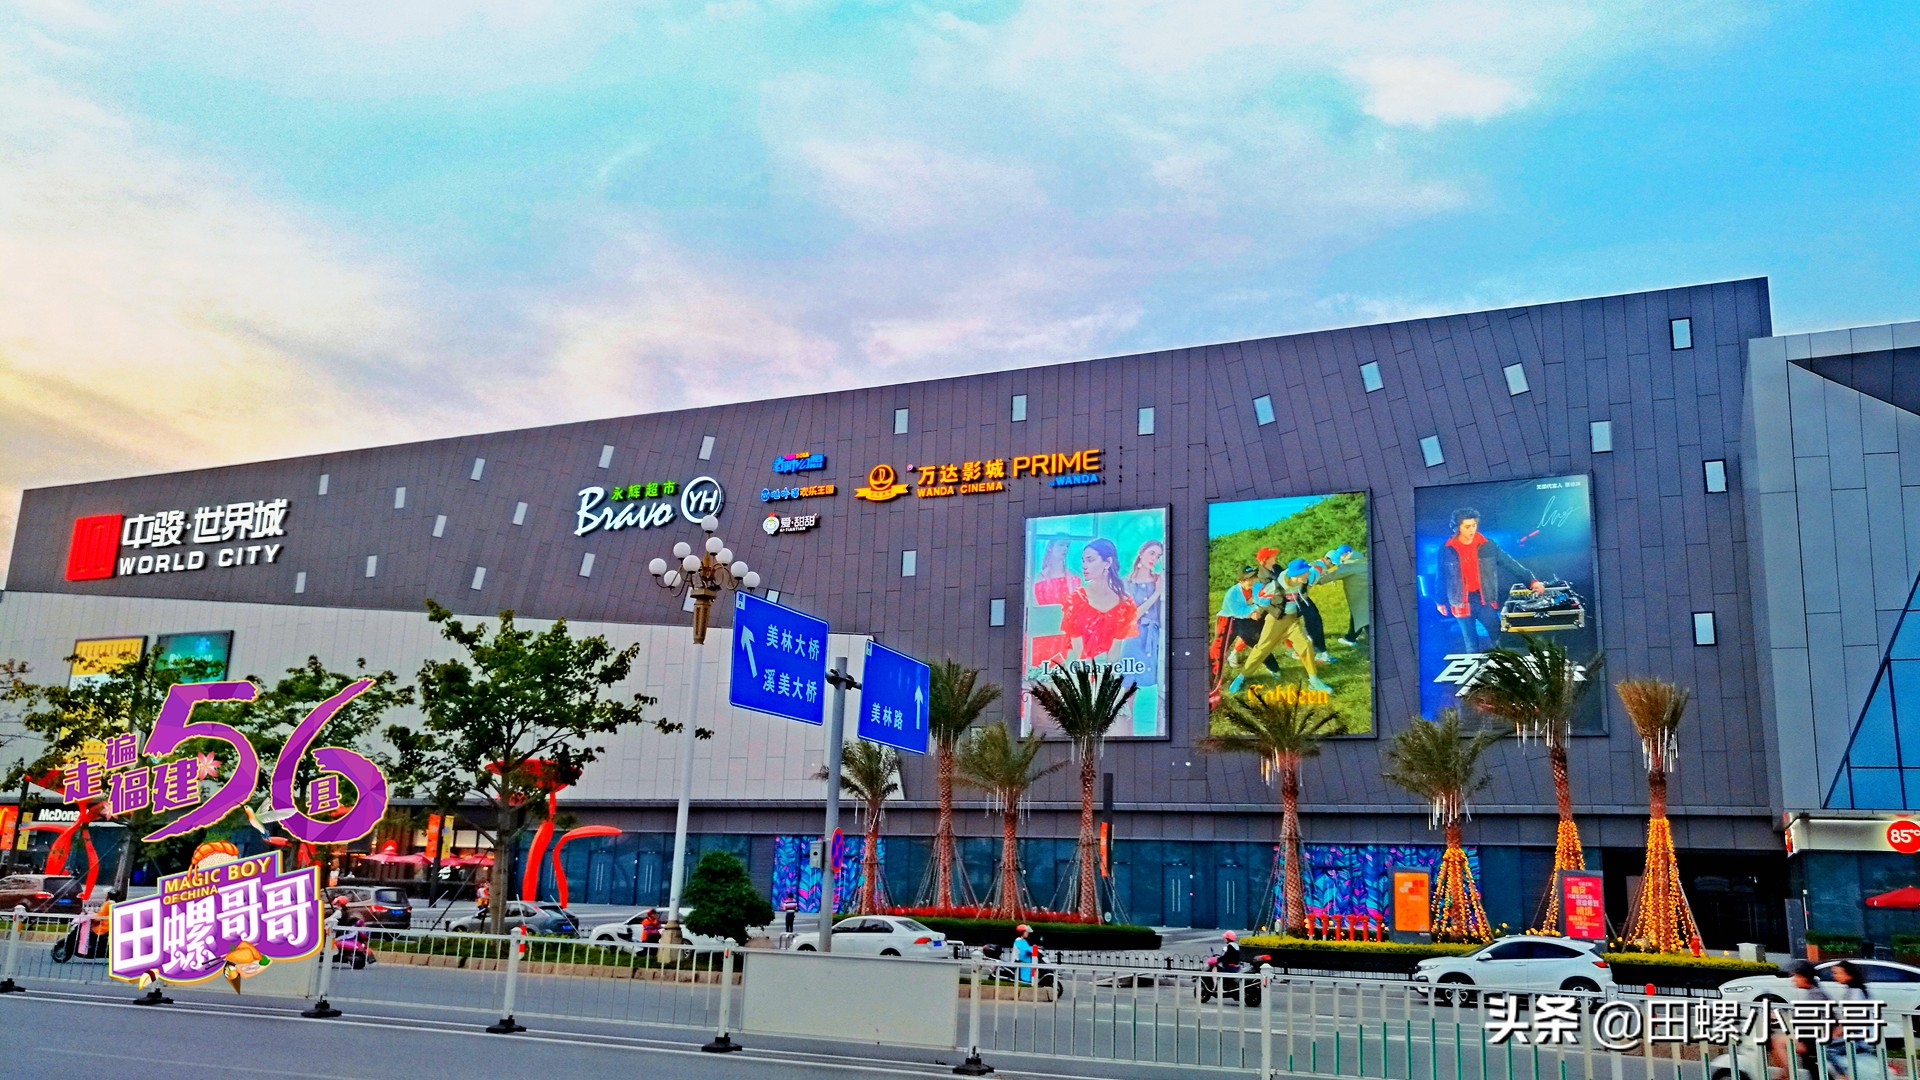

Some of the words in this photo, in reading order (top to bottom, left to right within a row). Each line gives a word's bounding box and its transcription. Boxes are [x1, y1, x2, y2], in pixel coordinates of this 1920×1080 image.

[918, 459, 1005, 485] 万达影城
[1013, 449, 1100, 477] PRIME
[611, 480, 676, 500] 永辉超市
[917, 485, 955, 498] WANDA
[960, 481, 1003, 494] CINEMA
[1055, 474, 1098, 486] WANDA
[574, 486, 674, 537] Bravo
[689, 490, 718, 513] YH
[119, 550, 206, 576] WORLD
[218, 544, 281, 568] CITY
[766, 624, 820, 662] 美林大桥
[1042, 661, 1064, 675] La
[762, 668, 818, 704] 溪美大桥
[1247, 683, 1329, 705] Cabbeen
[870, 702, 904, 731] 美林路
